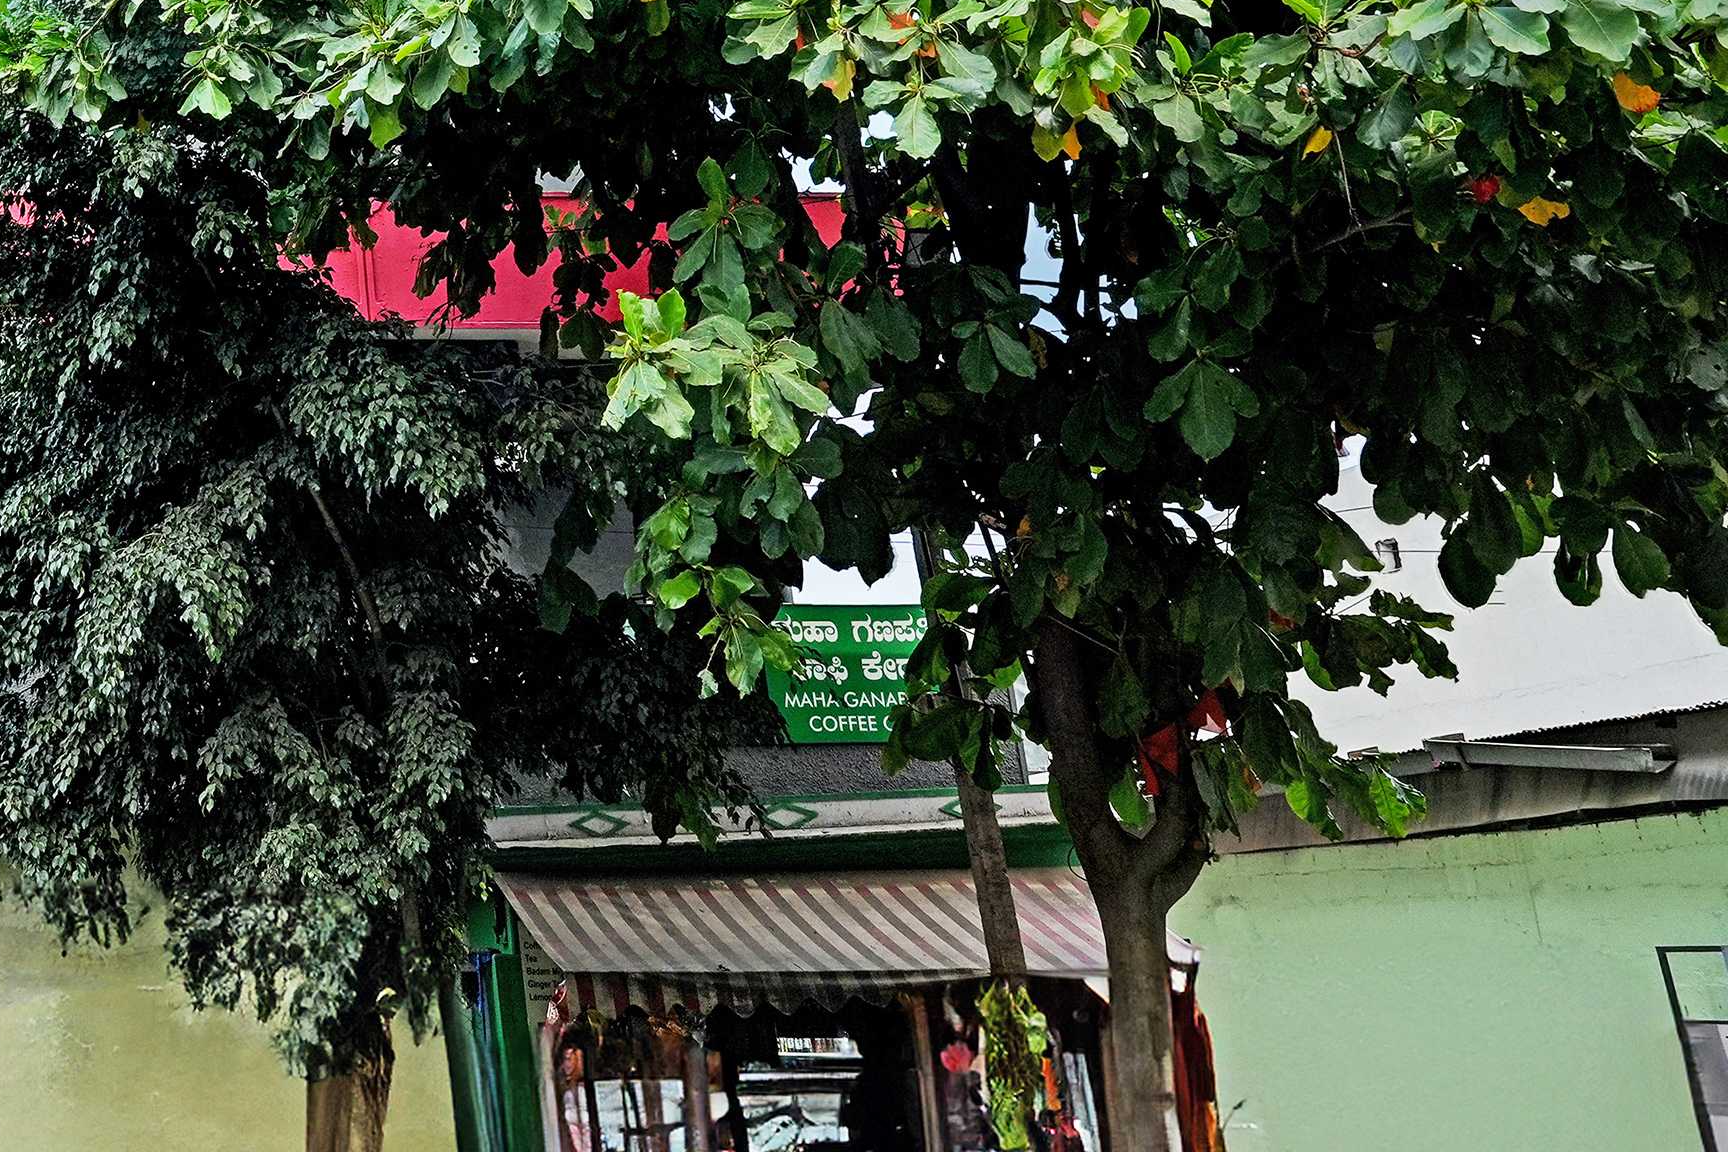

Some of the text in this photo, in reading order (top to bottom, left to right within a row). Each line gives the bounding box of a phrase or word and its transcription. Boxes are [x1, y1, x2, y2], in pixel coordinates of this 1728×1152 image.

[784, 691, 909, 708] MAHA GANAP
[809, 715, 878, 732] COFFEE
[524, 954, 538, 963] Tea
[526, 967, 551, 976] Badam
[527, 979, 551, 990] Ginger
